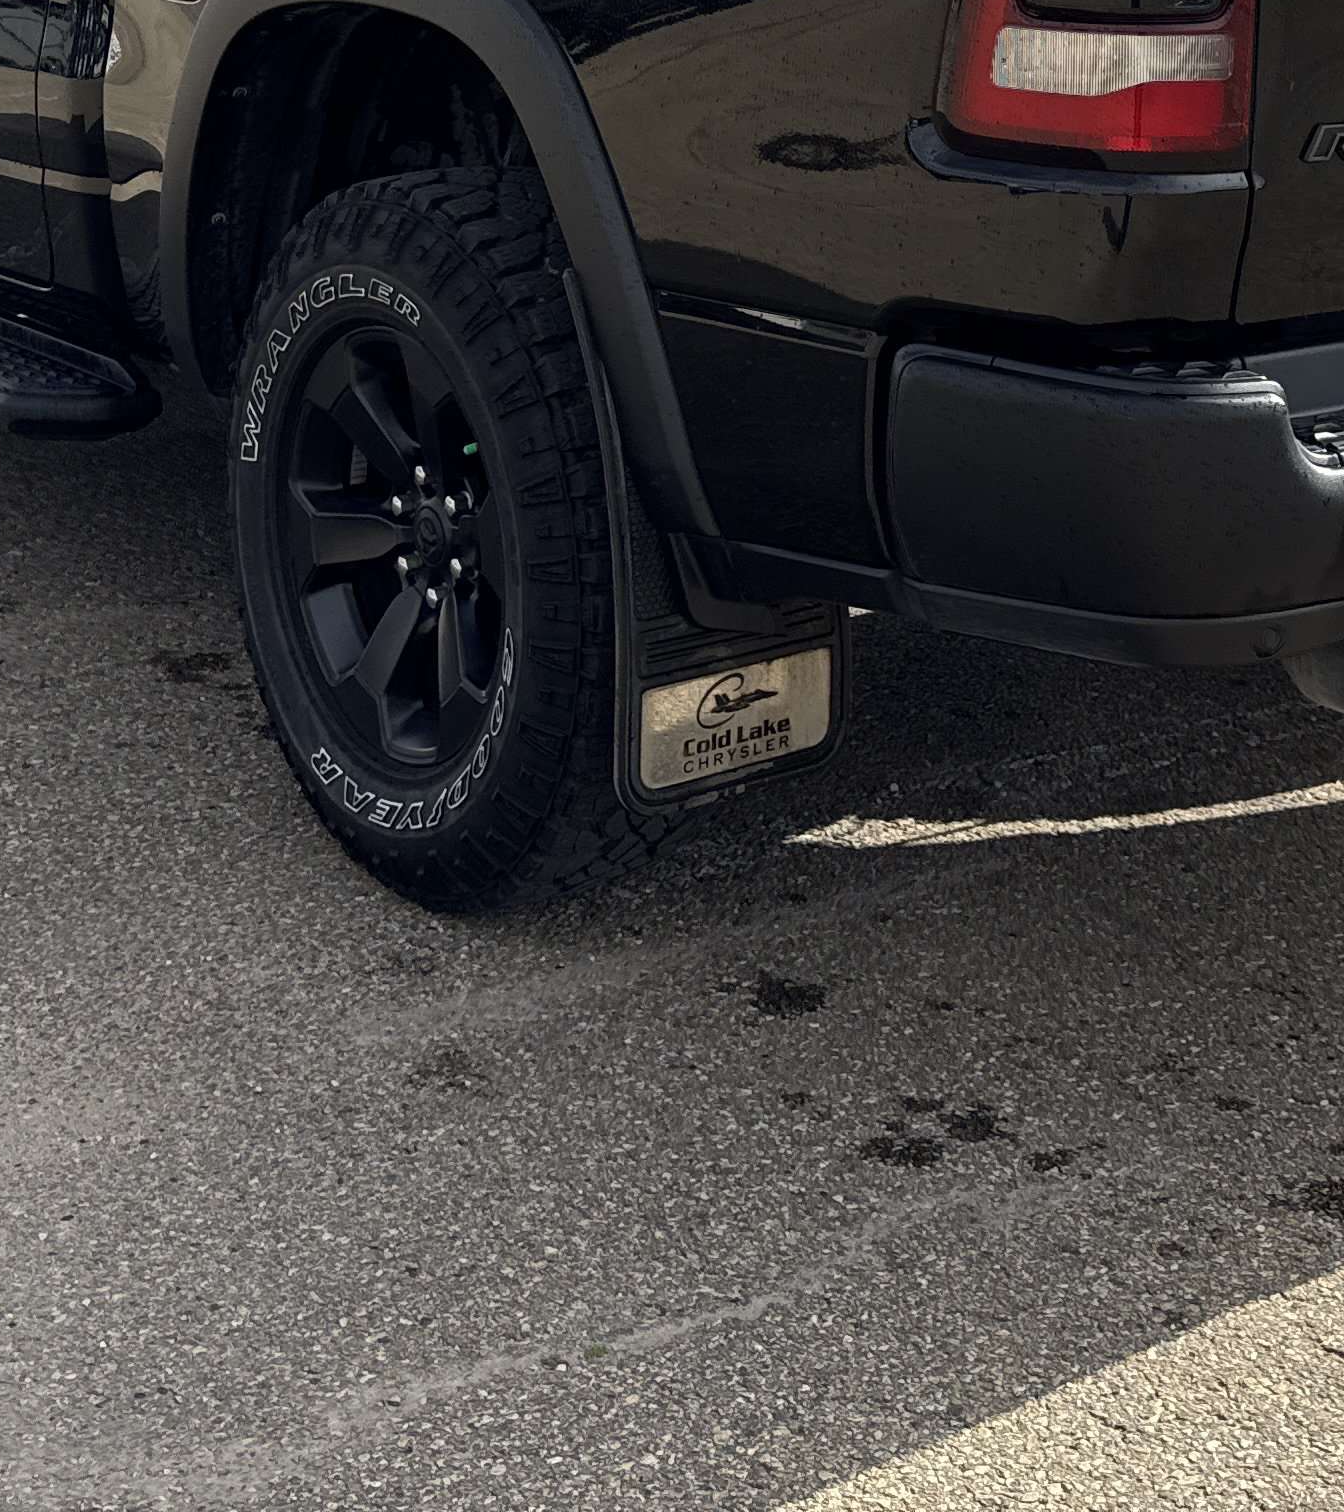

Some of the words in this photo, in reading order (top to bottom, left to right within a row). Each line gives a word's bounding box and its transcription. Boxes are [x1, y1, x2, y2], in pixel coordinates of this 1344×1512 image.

[241, 274, 421, 461] WRANGLER
[311, 627, 514, 830] GOODYEAR
[683, 729, 731, 757] Cold
[736, 718, 791, 744] Lake
[683, 735, 789, 774] CHRYSLER
